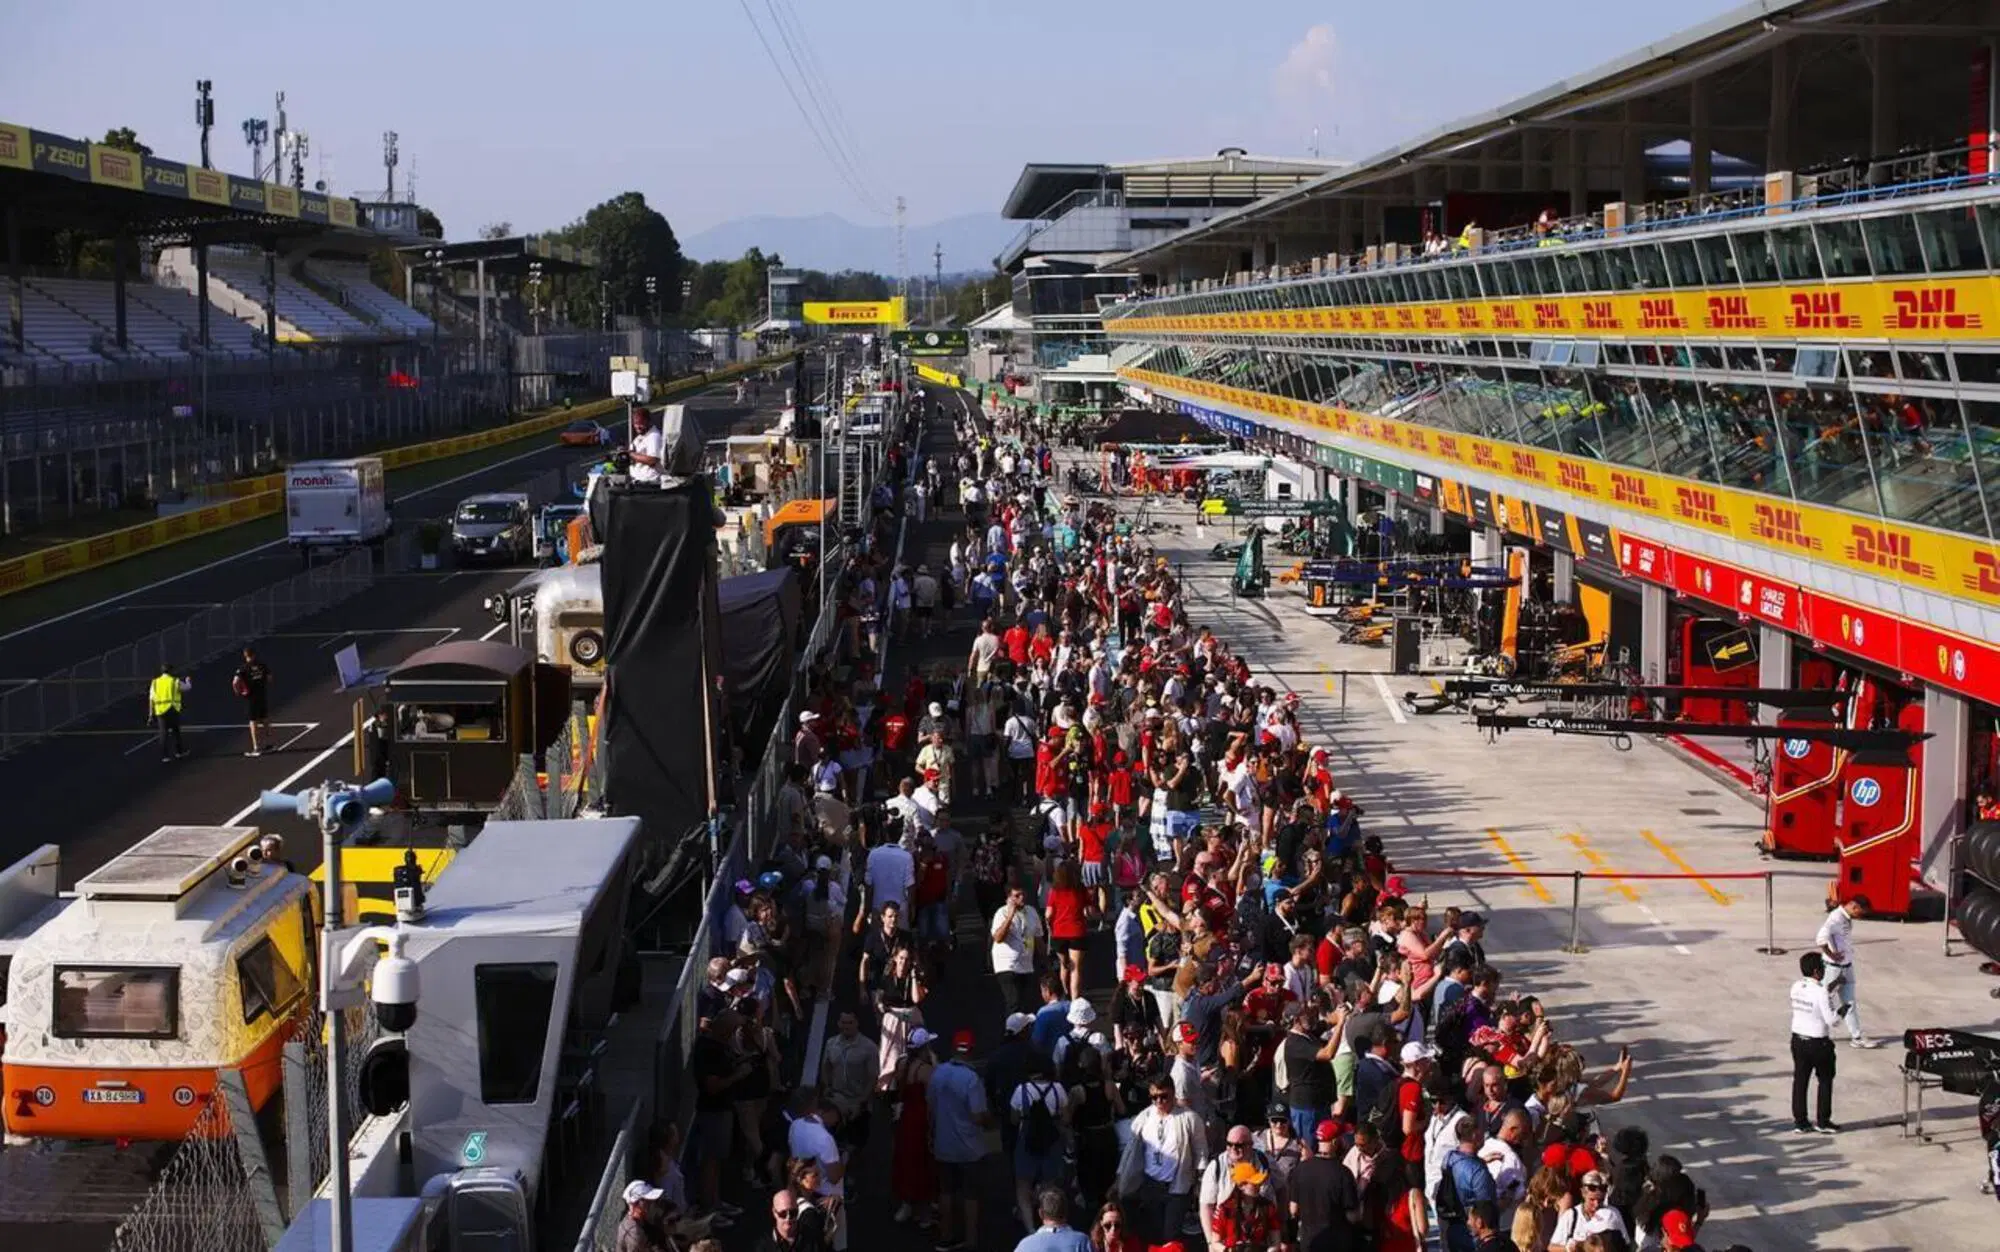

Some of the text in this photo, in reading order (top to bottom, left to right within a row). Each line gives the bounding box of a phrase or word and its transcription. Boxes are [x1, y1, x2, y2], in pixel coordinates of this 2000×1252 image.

[34, 143, 45, 160] P
[47, 145, 87, 169] ZERO
[156, 168, 186, 187] ZERO
[828, 307, 879, 319] PIRELLI
[1534, 303, 1565, 328] DHL
[1583, 302, 1619, 329] DHL
[1640, 299, 1682, 328] DHL
[1707, 297, 1757, 328] DHL
[1790, 292, 1853, 328] DHL
[1892, 288, 1968, 329] DHL
[1557, 461, 1593, 493] DHL
[1610, 473, 1652, 509] DHL
[1676, 487, 1725, 526] DHL
[1755, 504, 1812, 549] DHL
[1851, 525, 1922, 576] DHL
[1856, 778, 1878, 806] hp
